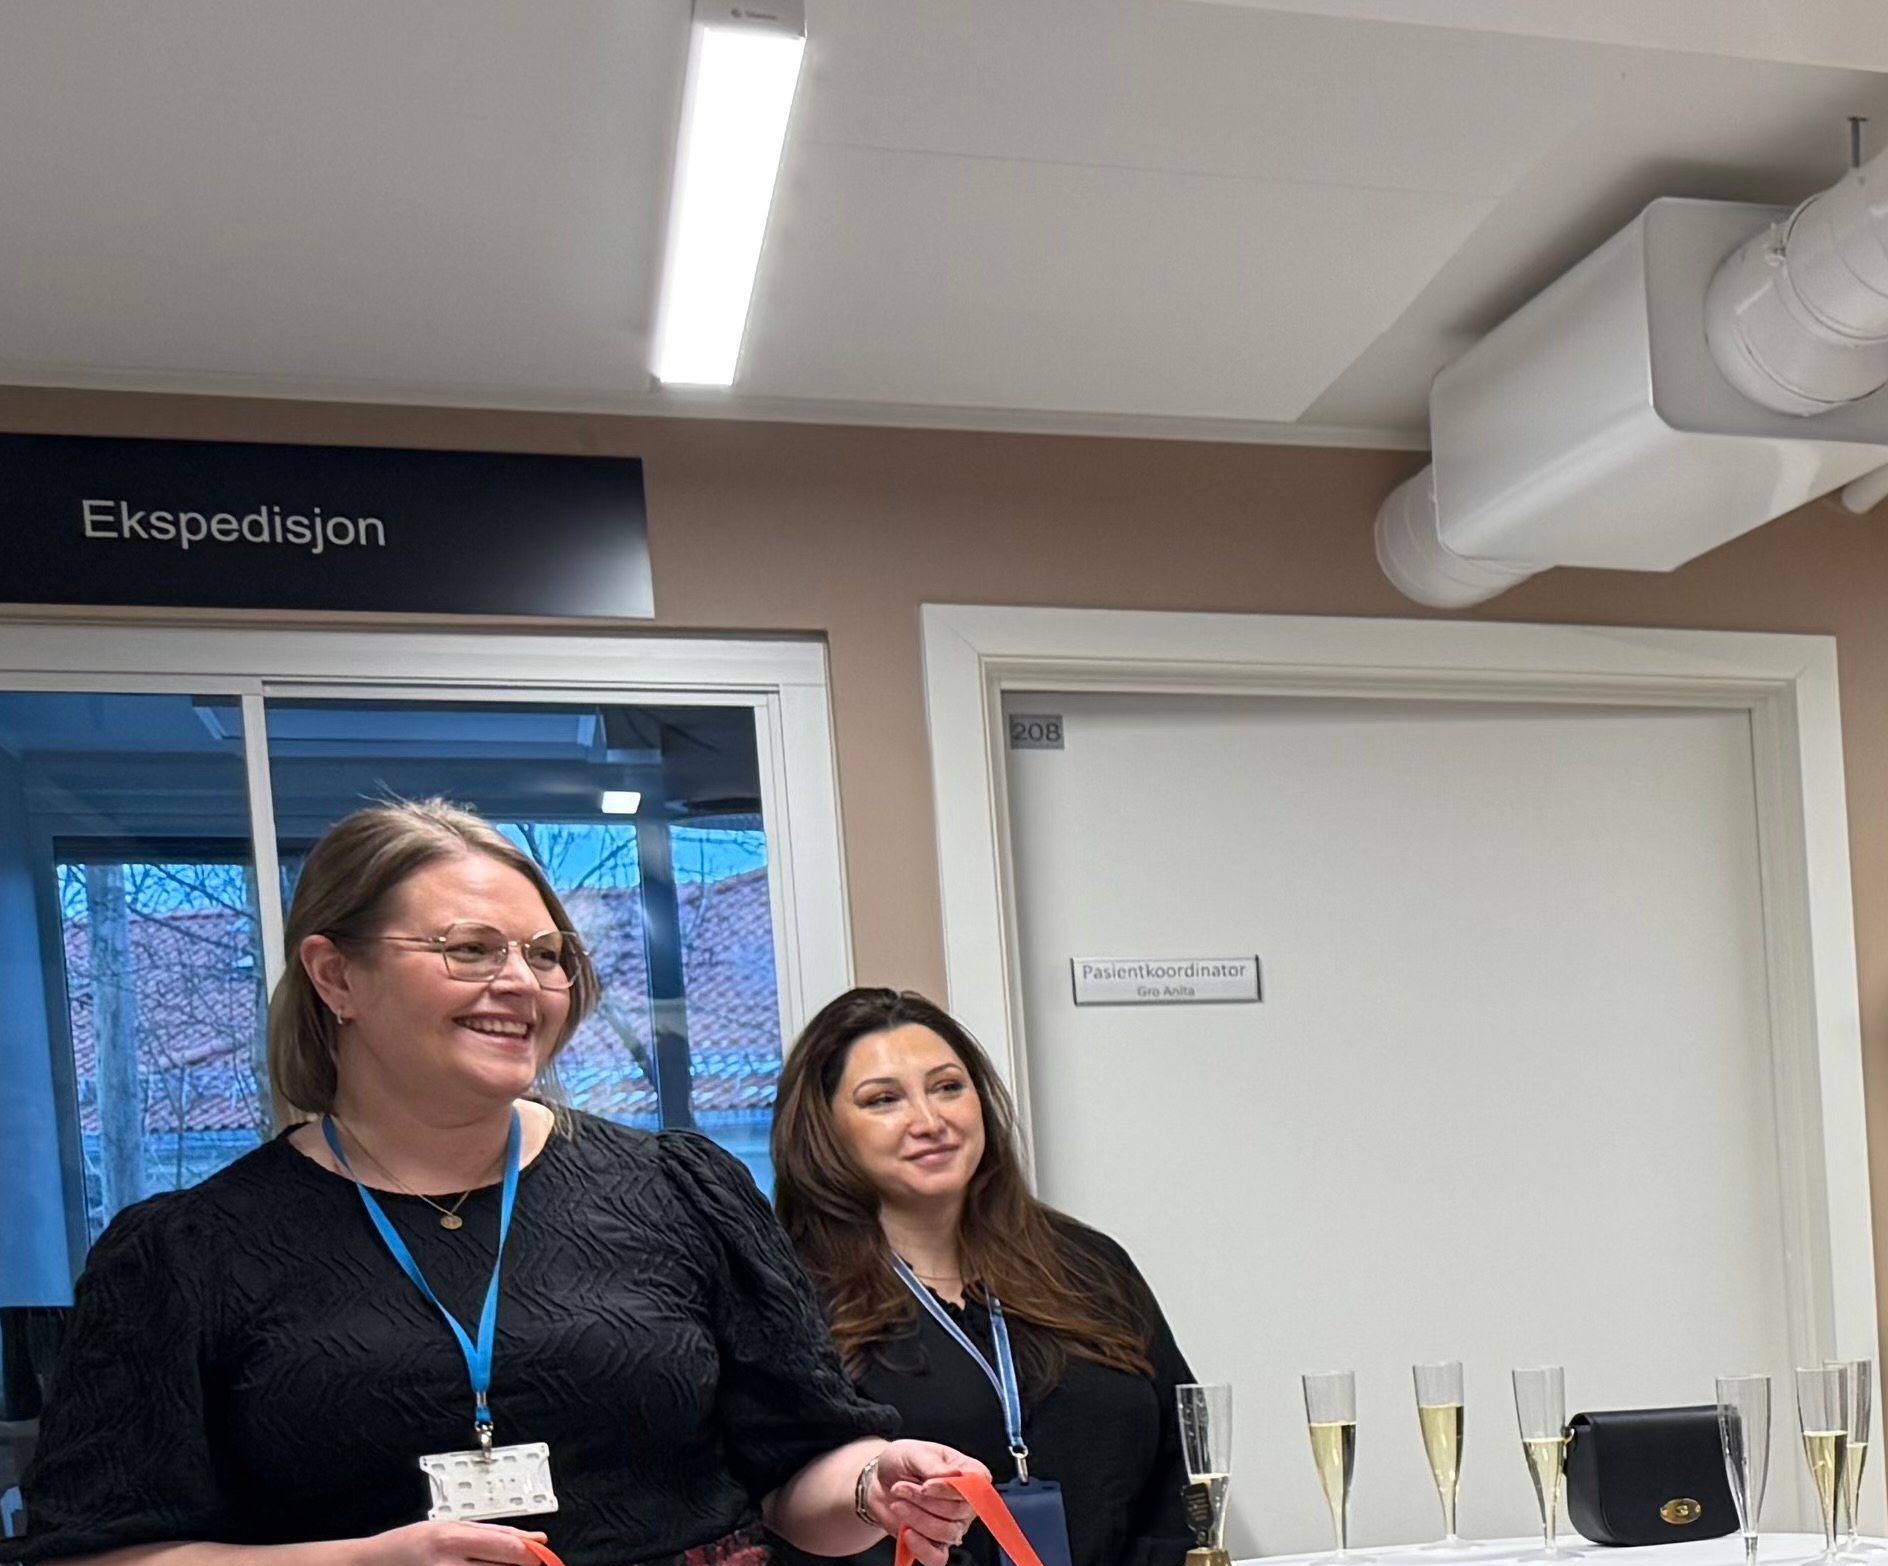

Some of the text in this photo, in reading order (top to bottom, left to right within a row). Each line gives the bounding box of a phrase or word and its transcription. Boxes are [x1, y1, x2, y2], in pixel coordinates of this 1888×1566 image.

[82, 499, 386, 555] Ekspedisjon
[1011, 721, 1061, 742] 208
[1082, 963, 1247, 980] Pasientkoordinator
